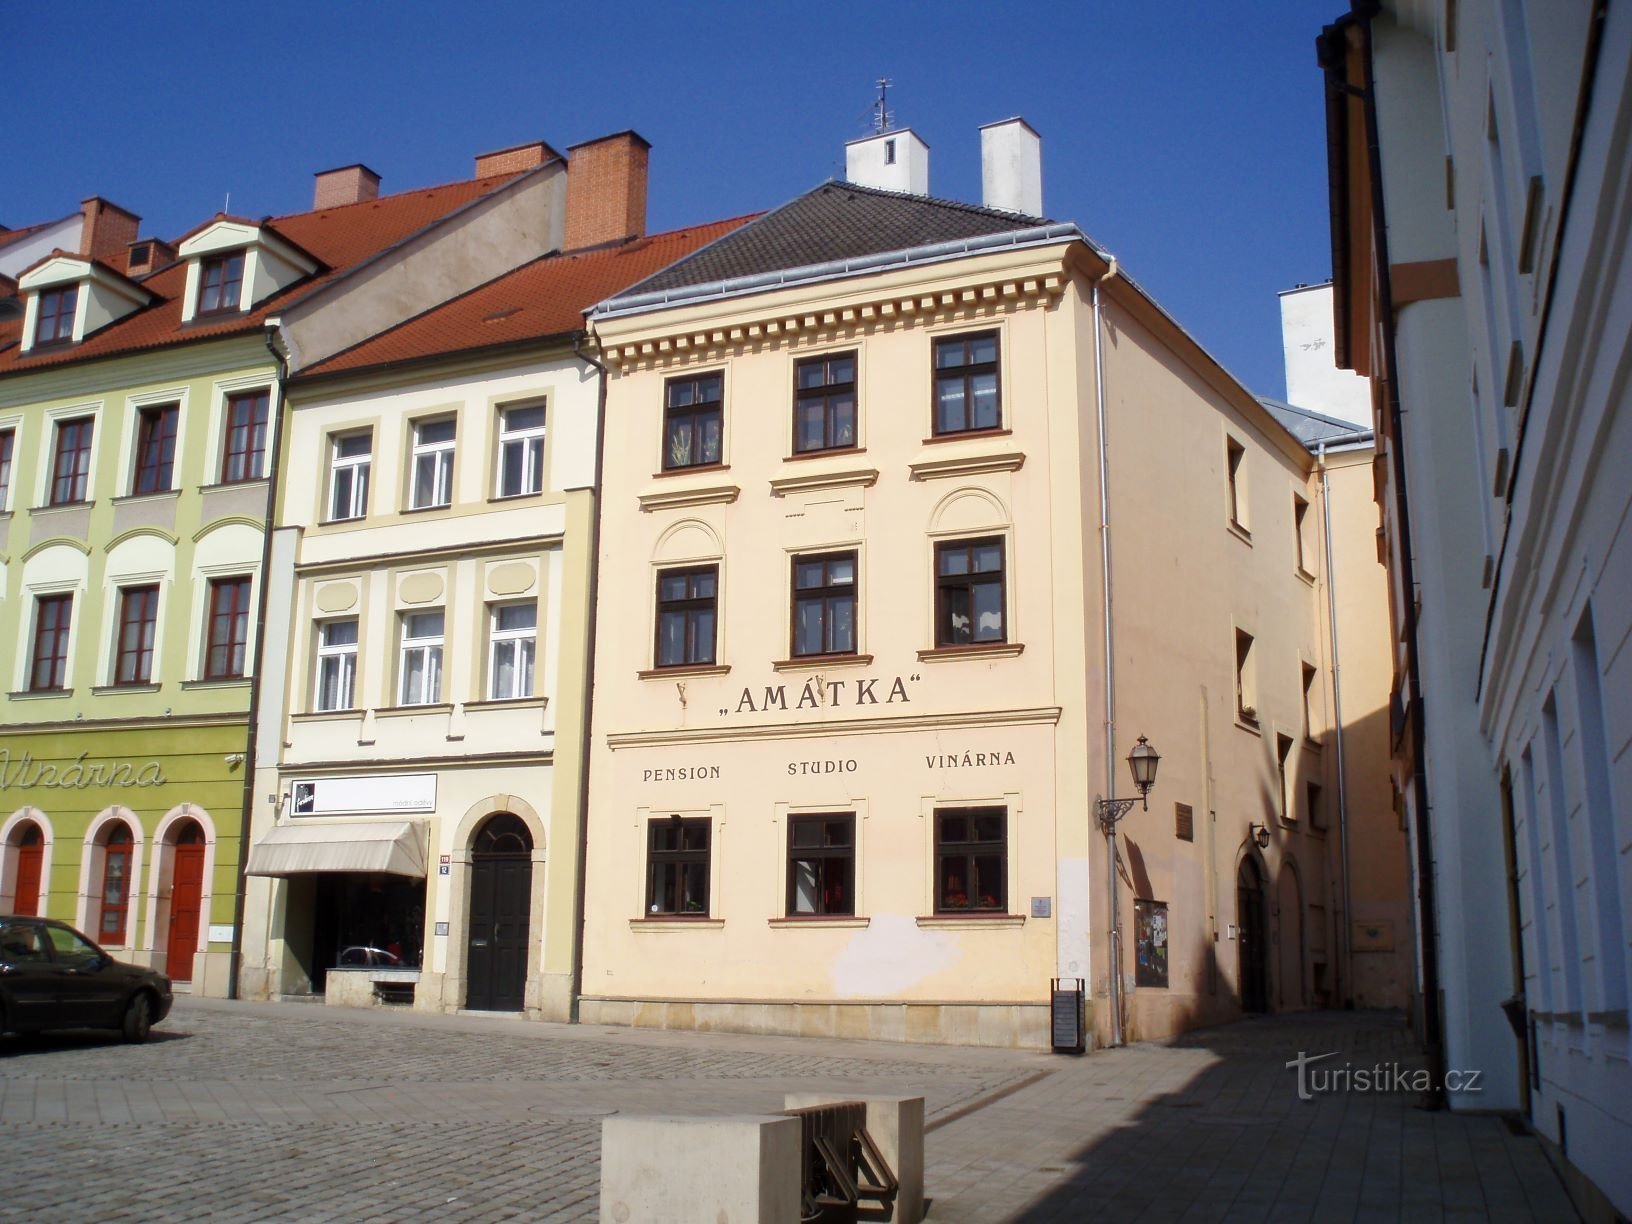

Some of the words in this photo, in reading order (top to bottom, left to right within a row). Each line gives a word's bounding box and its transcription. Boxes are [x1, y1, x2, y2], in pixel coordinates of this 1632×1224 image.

[0, 748, 167, 791] Vinárna
[643, 766, 721, 782] PENSION
[788, 759, 858, 775] STUDIO
[926, 750, 1016, 769] VINÁRNA
